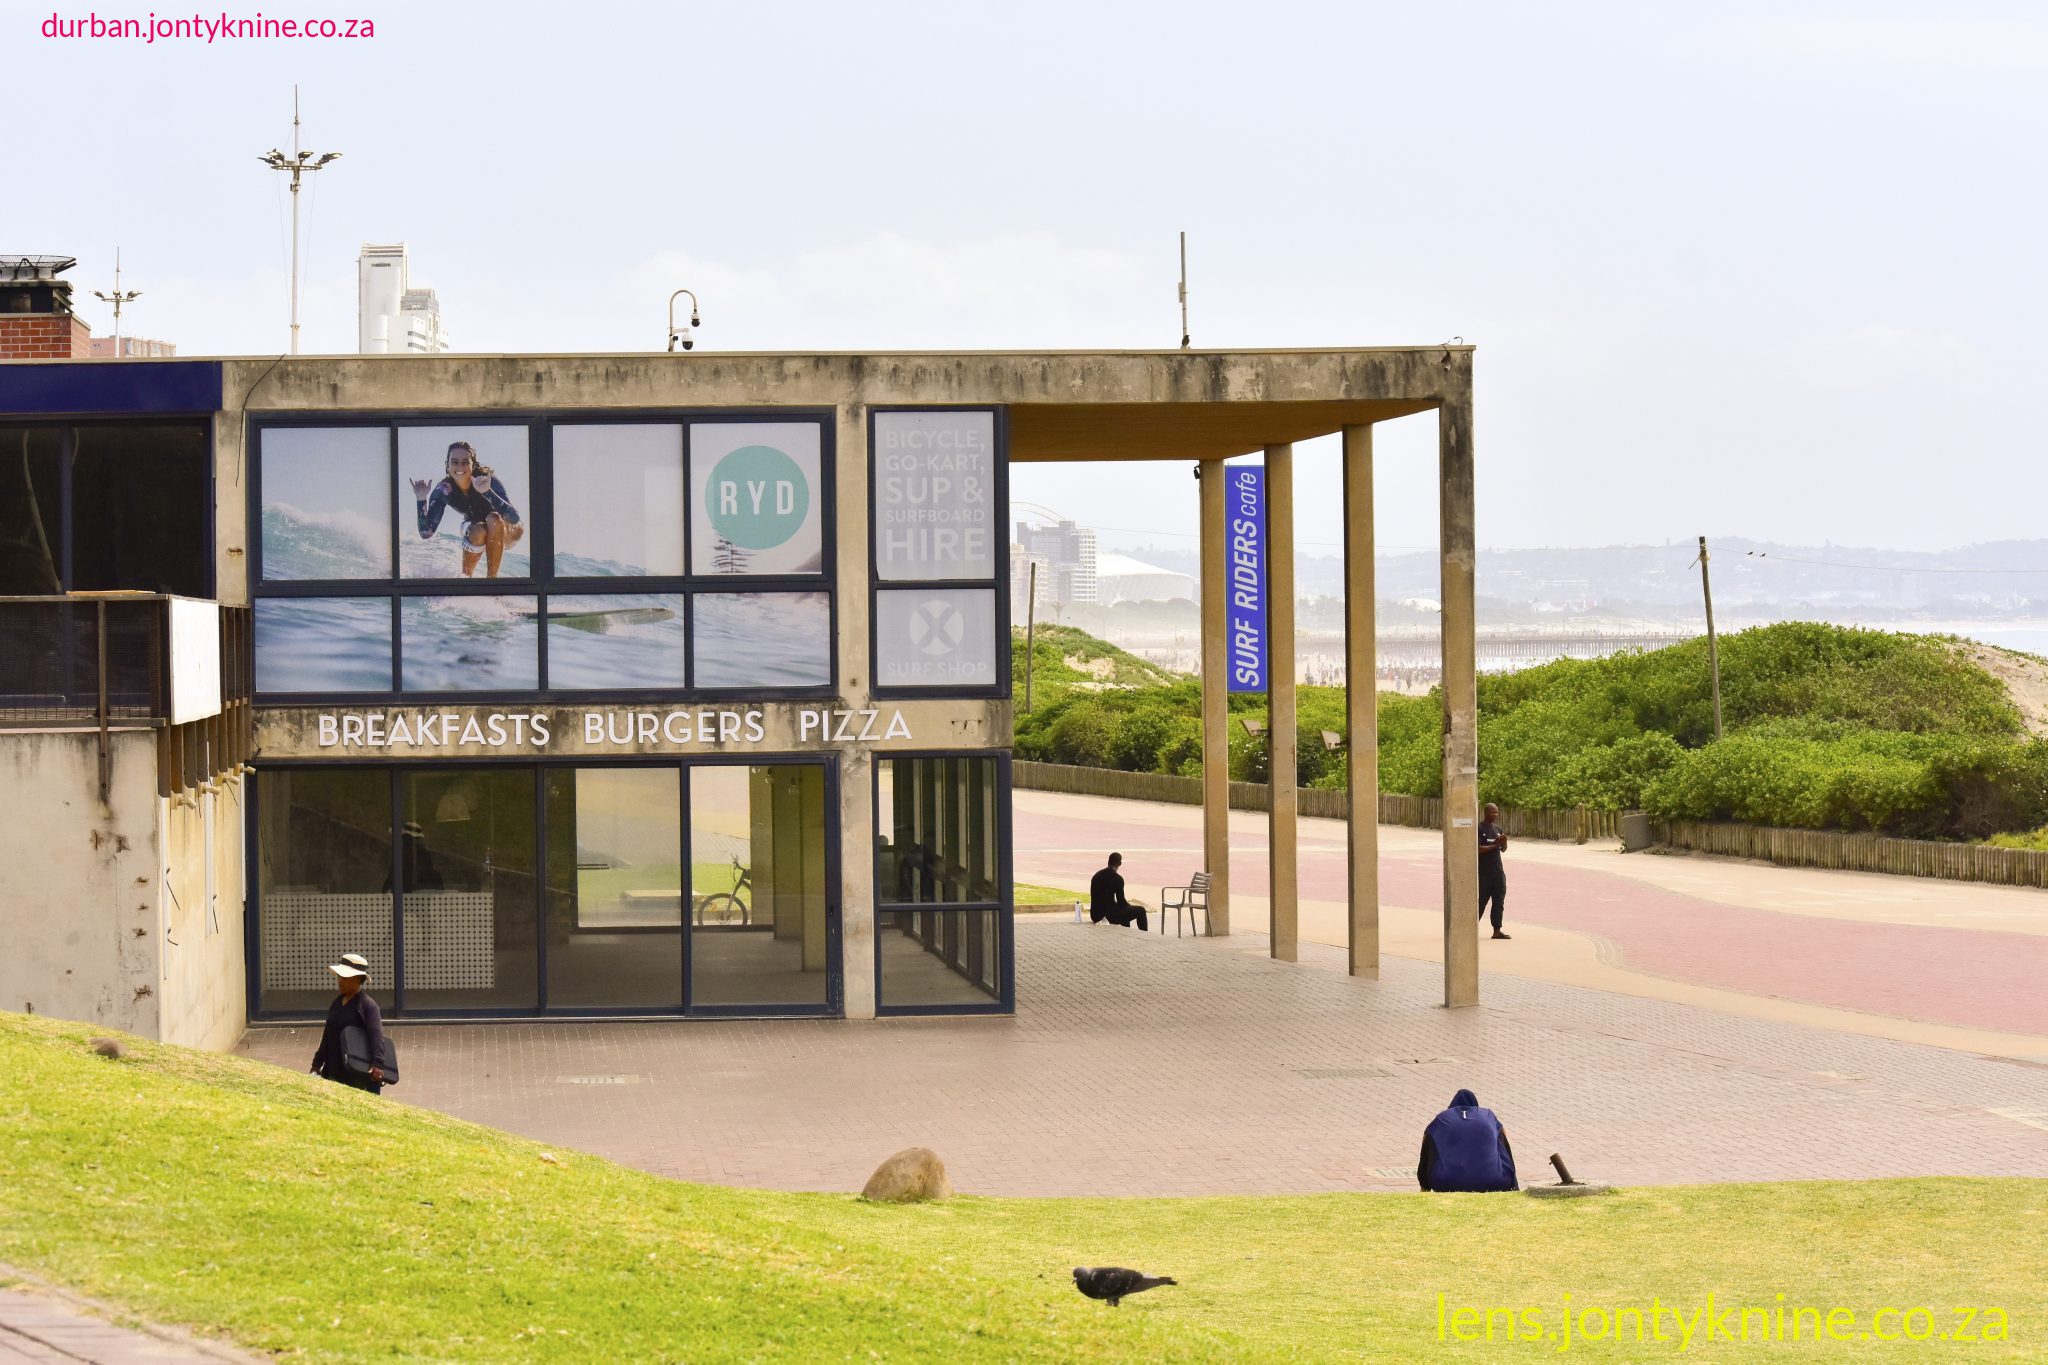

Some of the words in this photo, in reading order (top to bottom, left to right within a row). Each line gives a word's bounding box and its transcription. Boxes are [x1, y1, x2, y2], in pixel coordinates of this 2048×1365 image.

[886, 430, 985, 452] BICYCLE,
[886, 454, 985, 474] GO-KART,
[720, 480, 794, 515] RYD
[885, 476, 951, 504] SUP
[962, 476, 985, 504] &
[1235, 472, 1257, 517] cafe
[886, 509, 985, 523] SURFBOARD
[886, 528, 985, 561] HIRE
[1233, 518, 1258, 611] RIDERS
[1235, 617, 1260, 687] SURF
[887, 662, 933, 678] SURF
[937, 661, 987, 677] SHOP
[318, 713, 551, 748] BREAKFASTS
[584, 710, 765, 745] BURGERS
[799, 709, 913, 742] PIZZA
